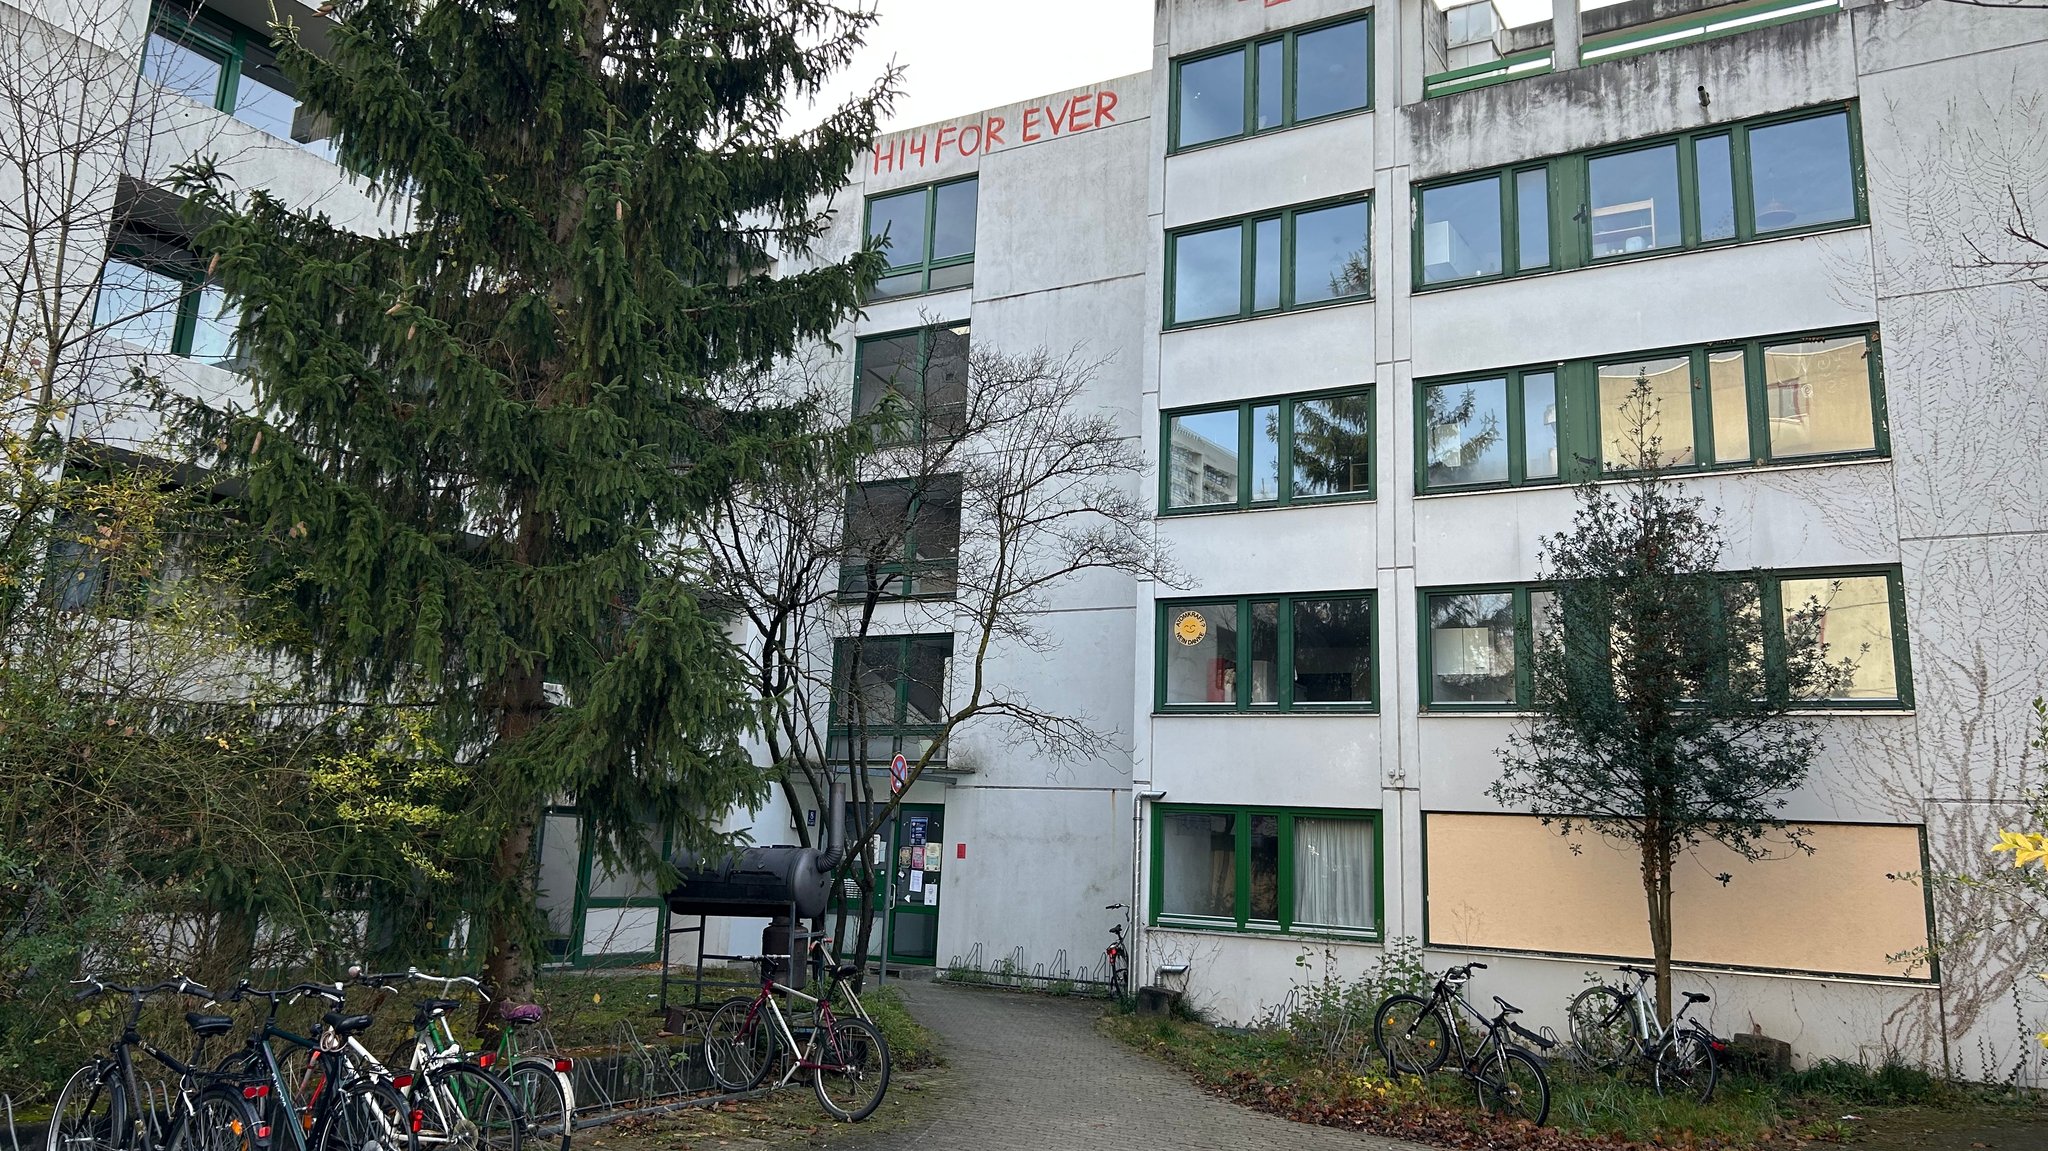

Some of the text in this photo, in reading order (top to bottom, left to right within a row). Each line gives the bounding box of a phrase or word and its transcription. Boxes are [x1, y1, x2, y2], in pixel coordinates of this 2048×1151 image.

[935, 116, 1005, 163] FOR
[1022, 91, 1118, 142] EVER
[1176, 632, 1204, 645] NEIN DANKE
